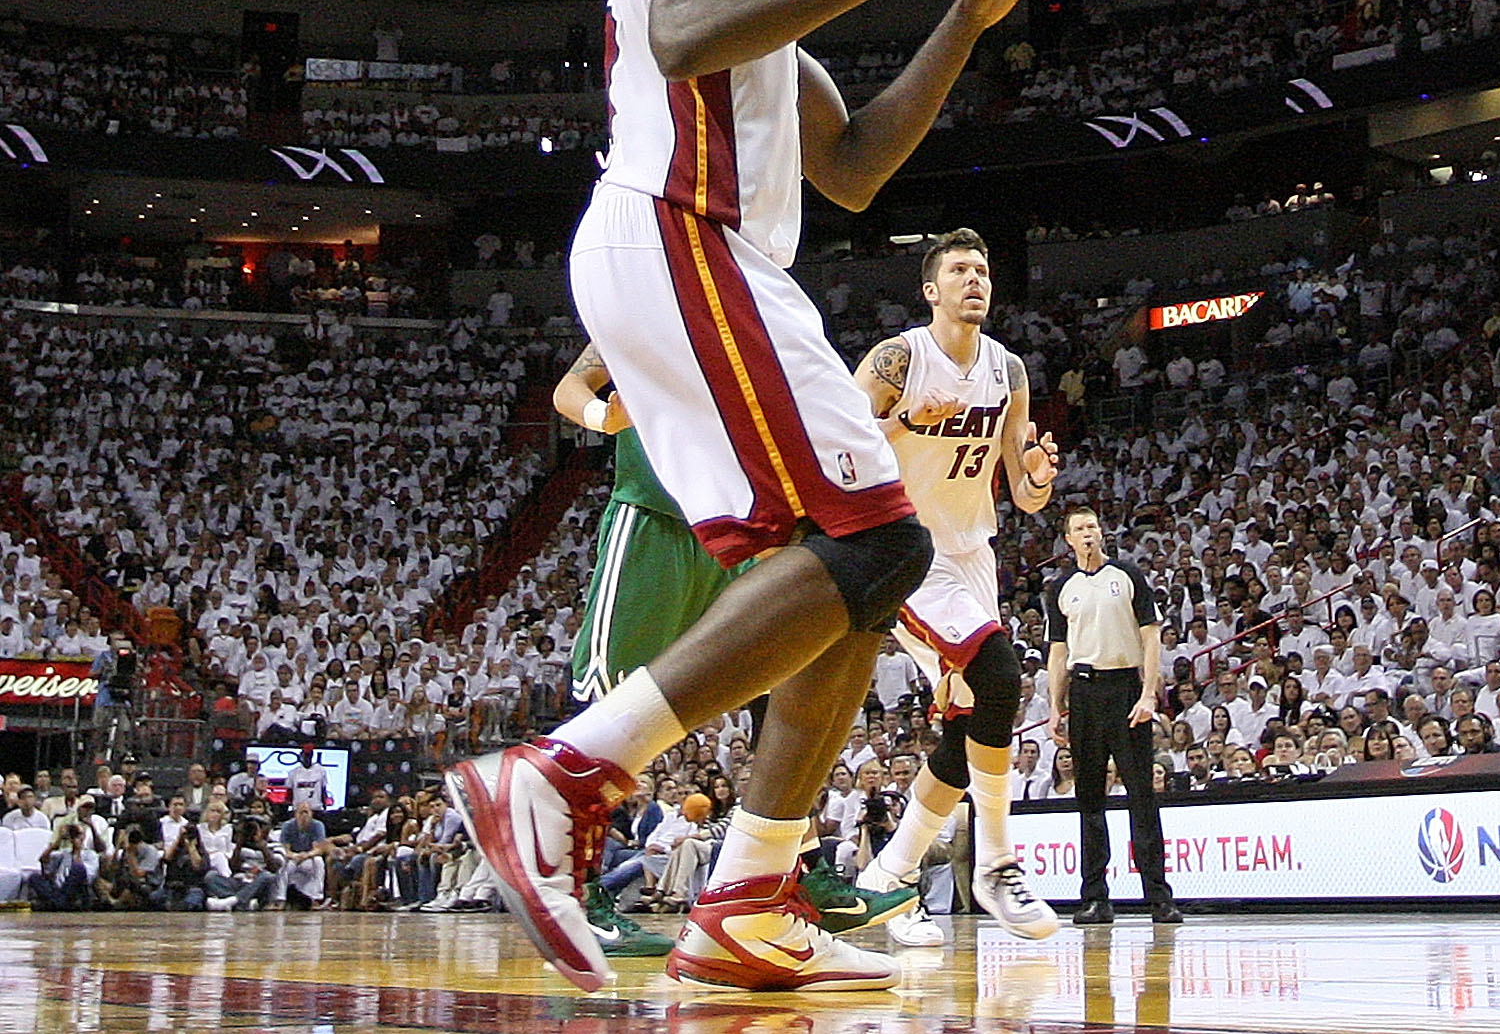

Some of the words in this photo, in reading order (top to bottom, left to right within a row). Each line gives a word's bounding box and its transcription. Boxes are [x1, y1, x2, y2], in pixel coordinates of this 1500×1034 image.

[946, 443, 991, 481] 13
[1034, 842, 1118, 879] STO,
[1128, 838, 1208, 874] EERY
[1216, 834, 1303, 872] TEAM.
